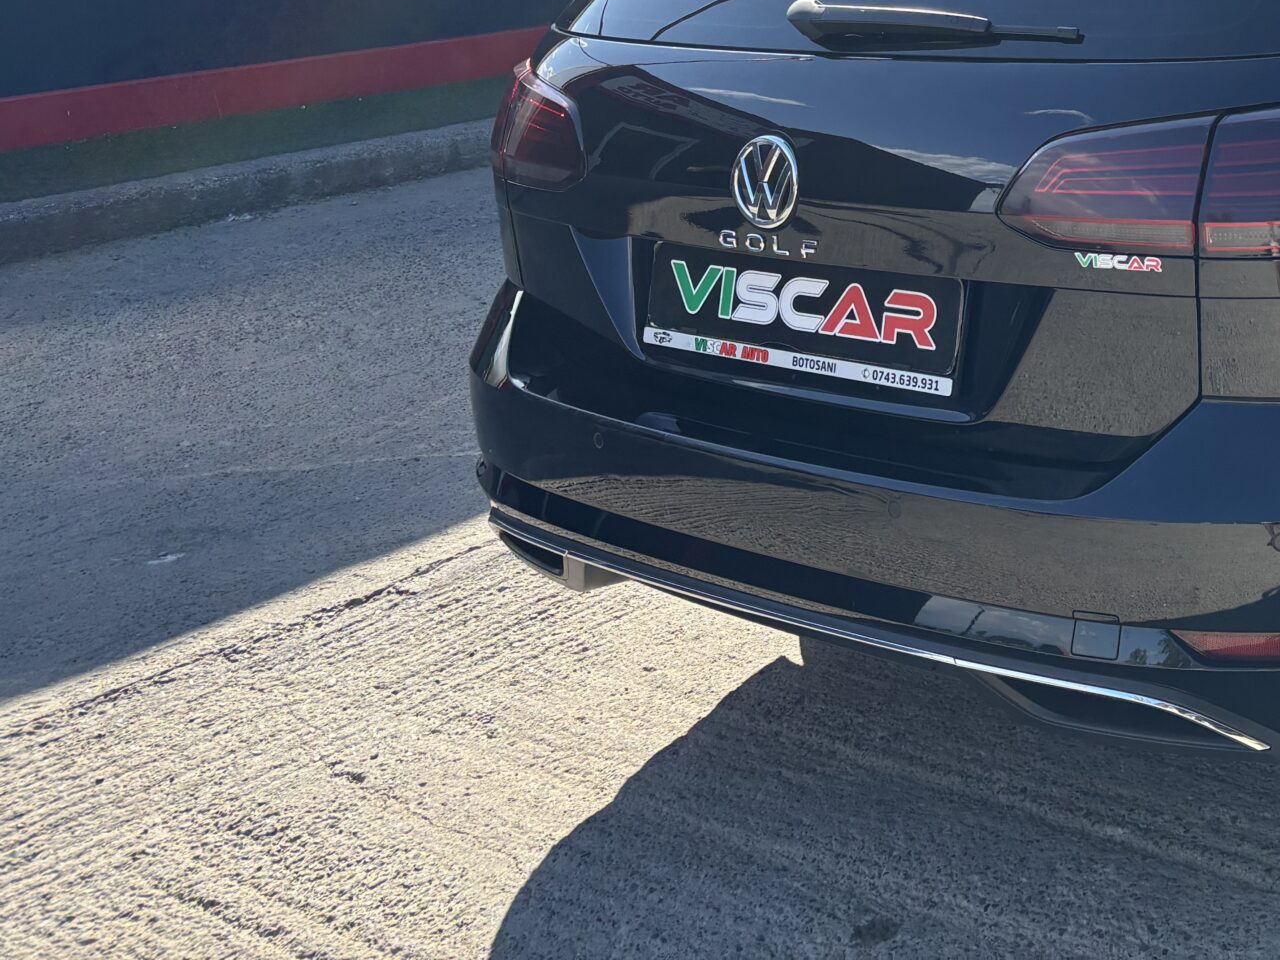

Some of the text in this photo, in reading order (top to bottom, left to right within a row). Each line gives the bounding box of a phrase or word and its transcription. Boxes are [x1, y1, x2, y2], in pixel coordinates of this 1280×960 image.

[719, 229, 818, 258] GOLF
[1074, 252, 1162, 272] VISCAR
[671, 259, 937, 350] VISCAR
[694, 337, 940, 392] VISCAR AUTO BOTOSANI 0743.639.931
